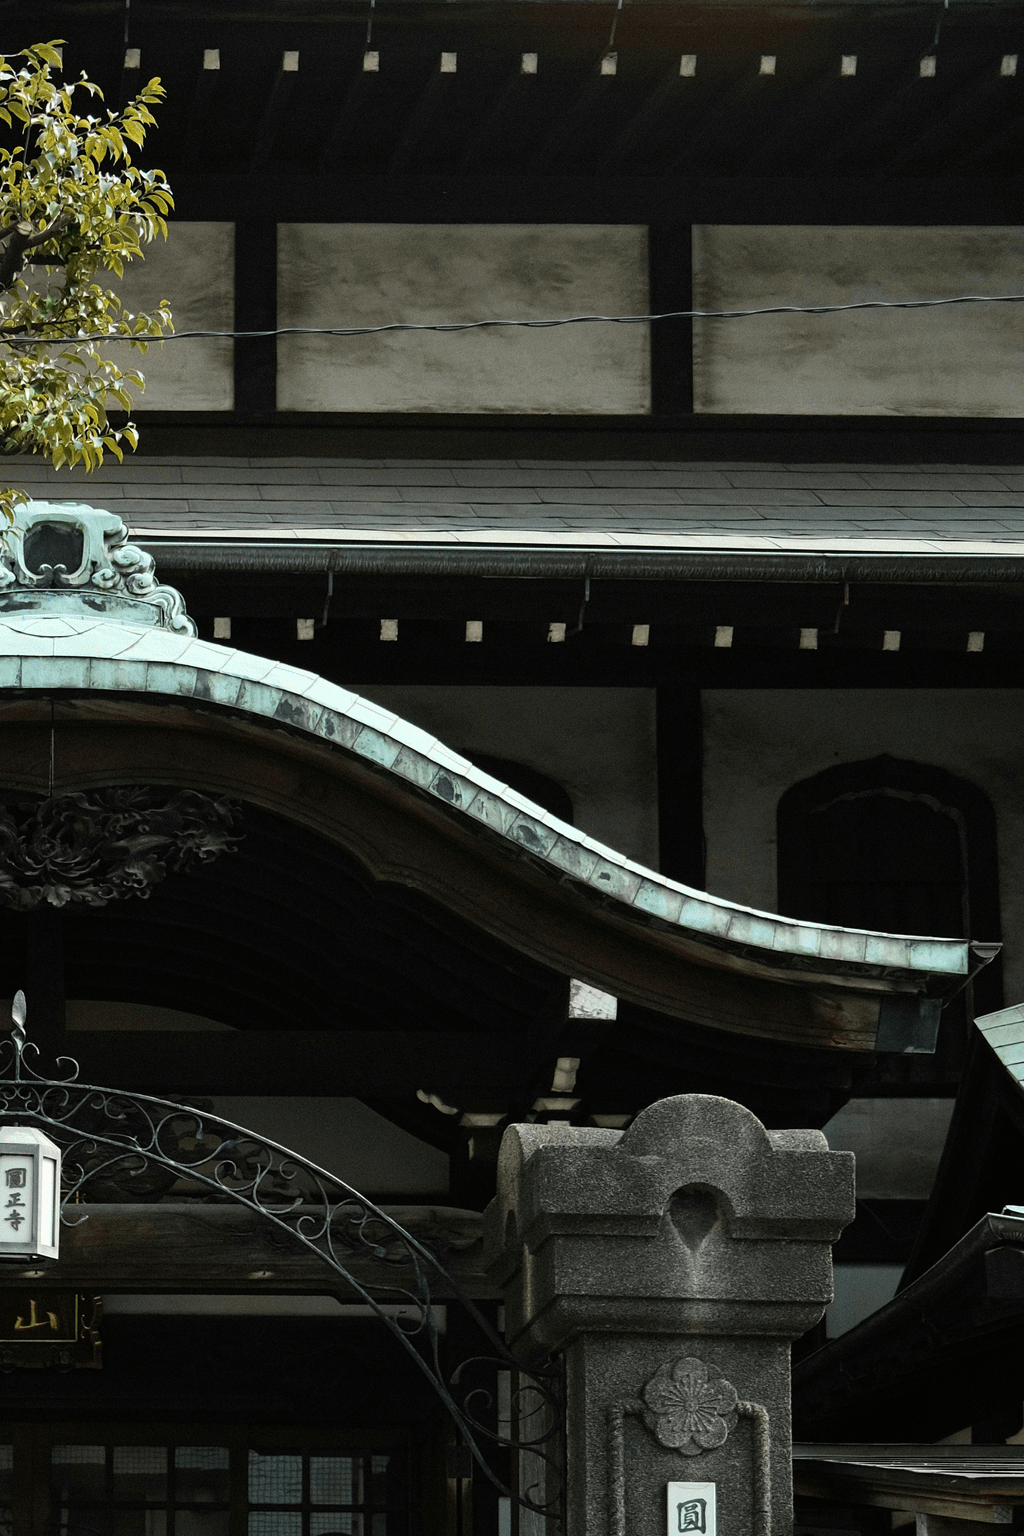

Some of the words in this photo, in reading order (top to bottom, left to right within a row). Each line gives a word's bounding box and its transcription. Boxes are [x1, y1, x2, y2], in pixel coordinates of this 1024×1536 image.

[4, 1167, 27, 1232] 圓正寺
[14, 1299, 58, 1330] 山
